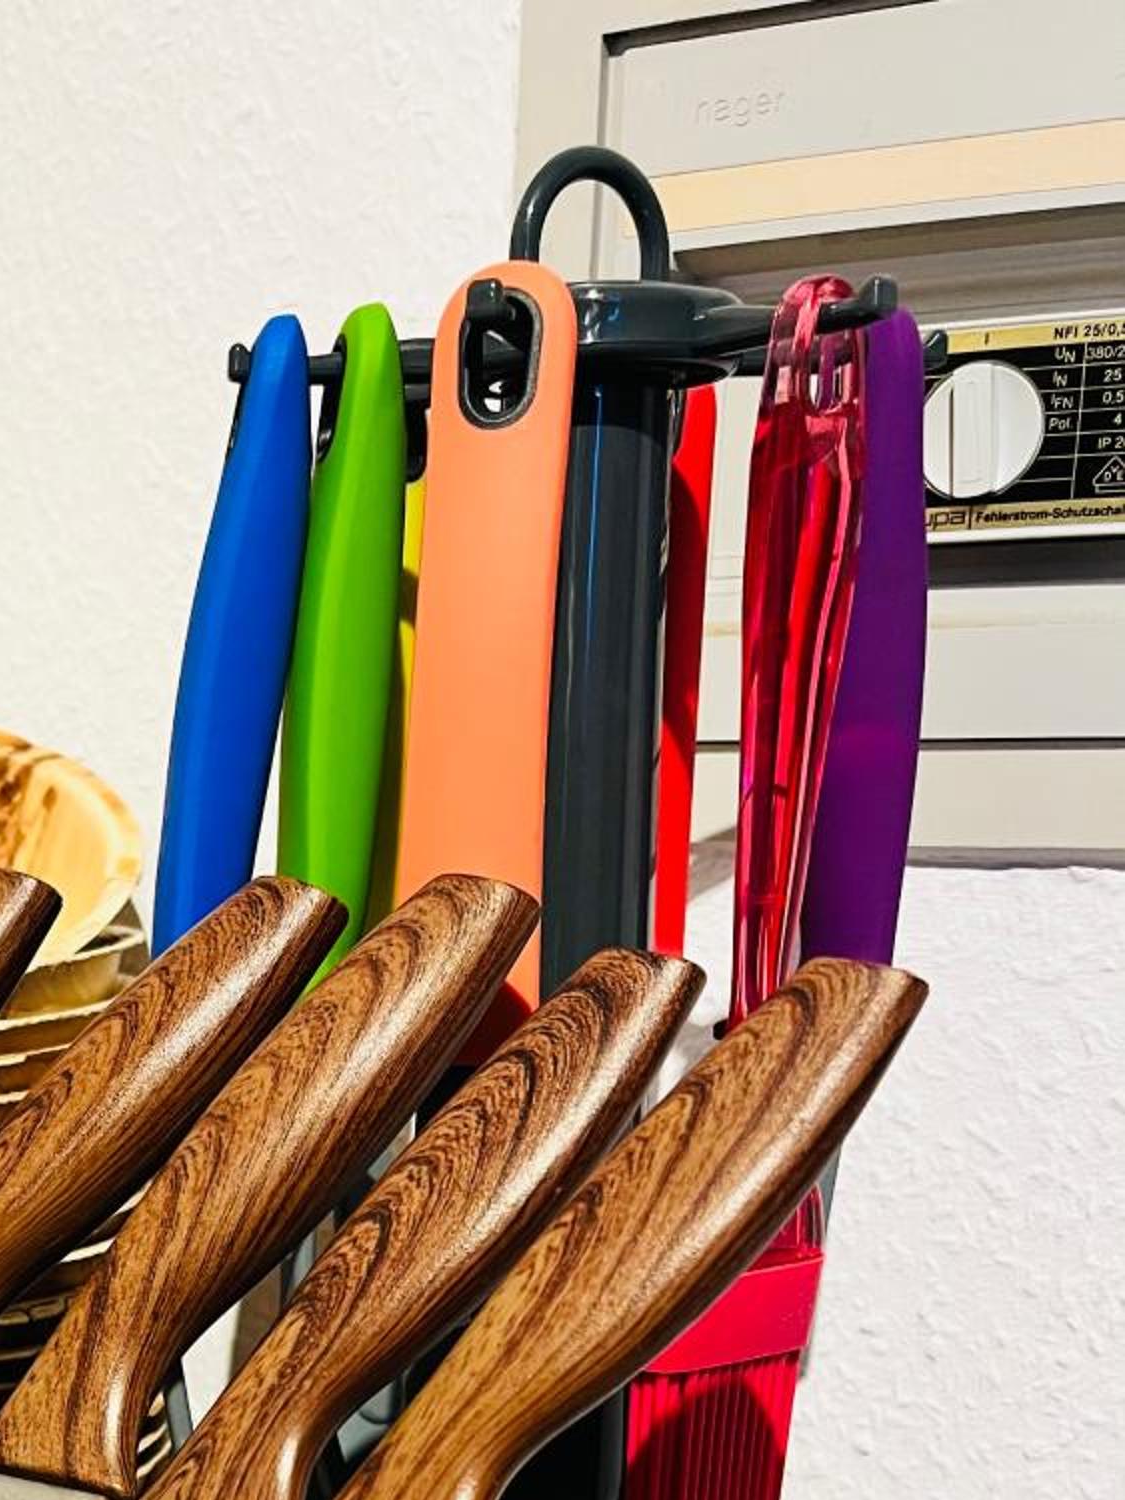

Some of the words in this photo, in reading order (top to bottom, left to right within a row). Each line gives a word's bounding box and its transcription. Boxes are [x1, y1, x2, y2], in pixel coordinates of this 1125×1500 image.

[1053, 325, 1078, 339] NFI
[1103, 368, 1122, 382] 25
[1114, 412, 1122, 426] 4
